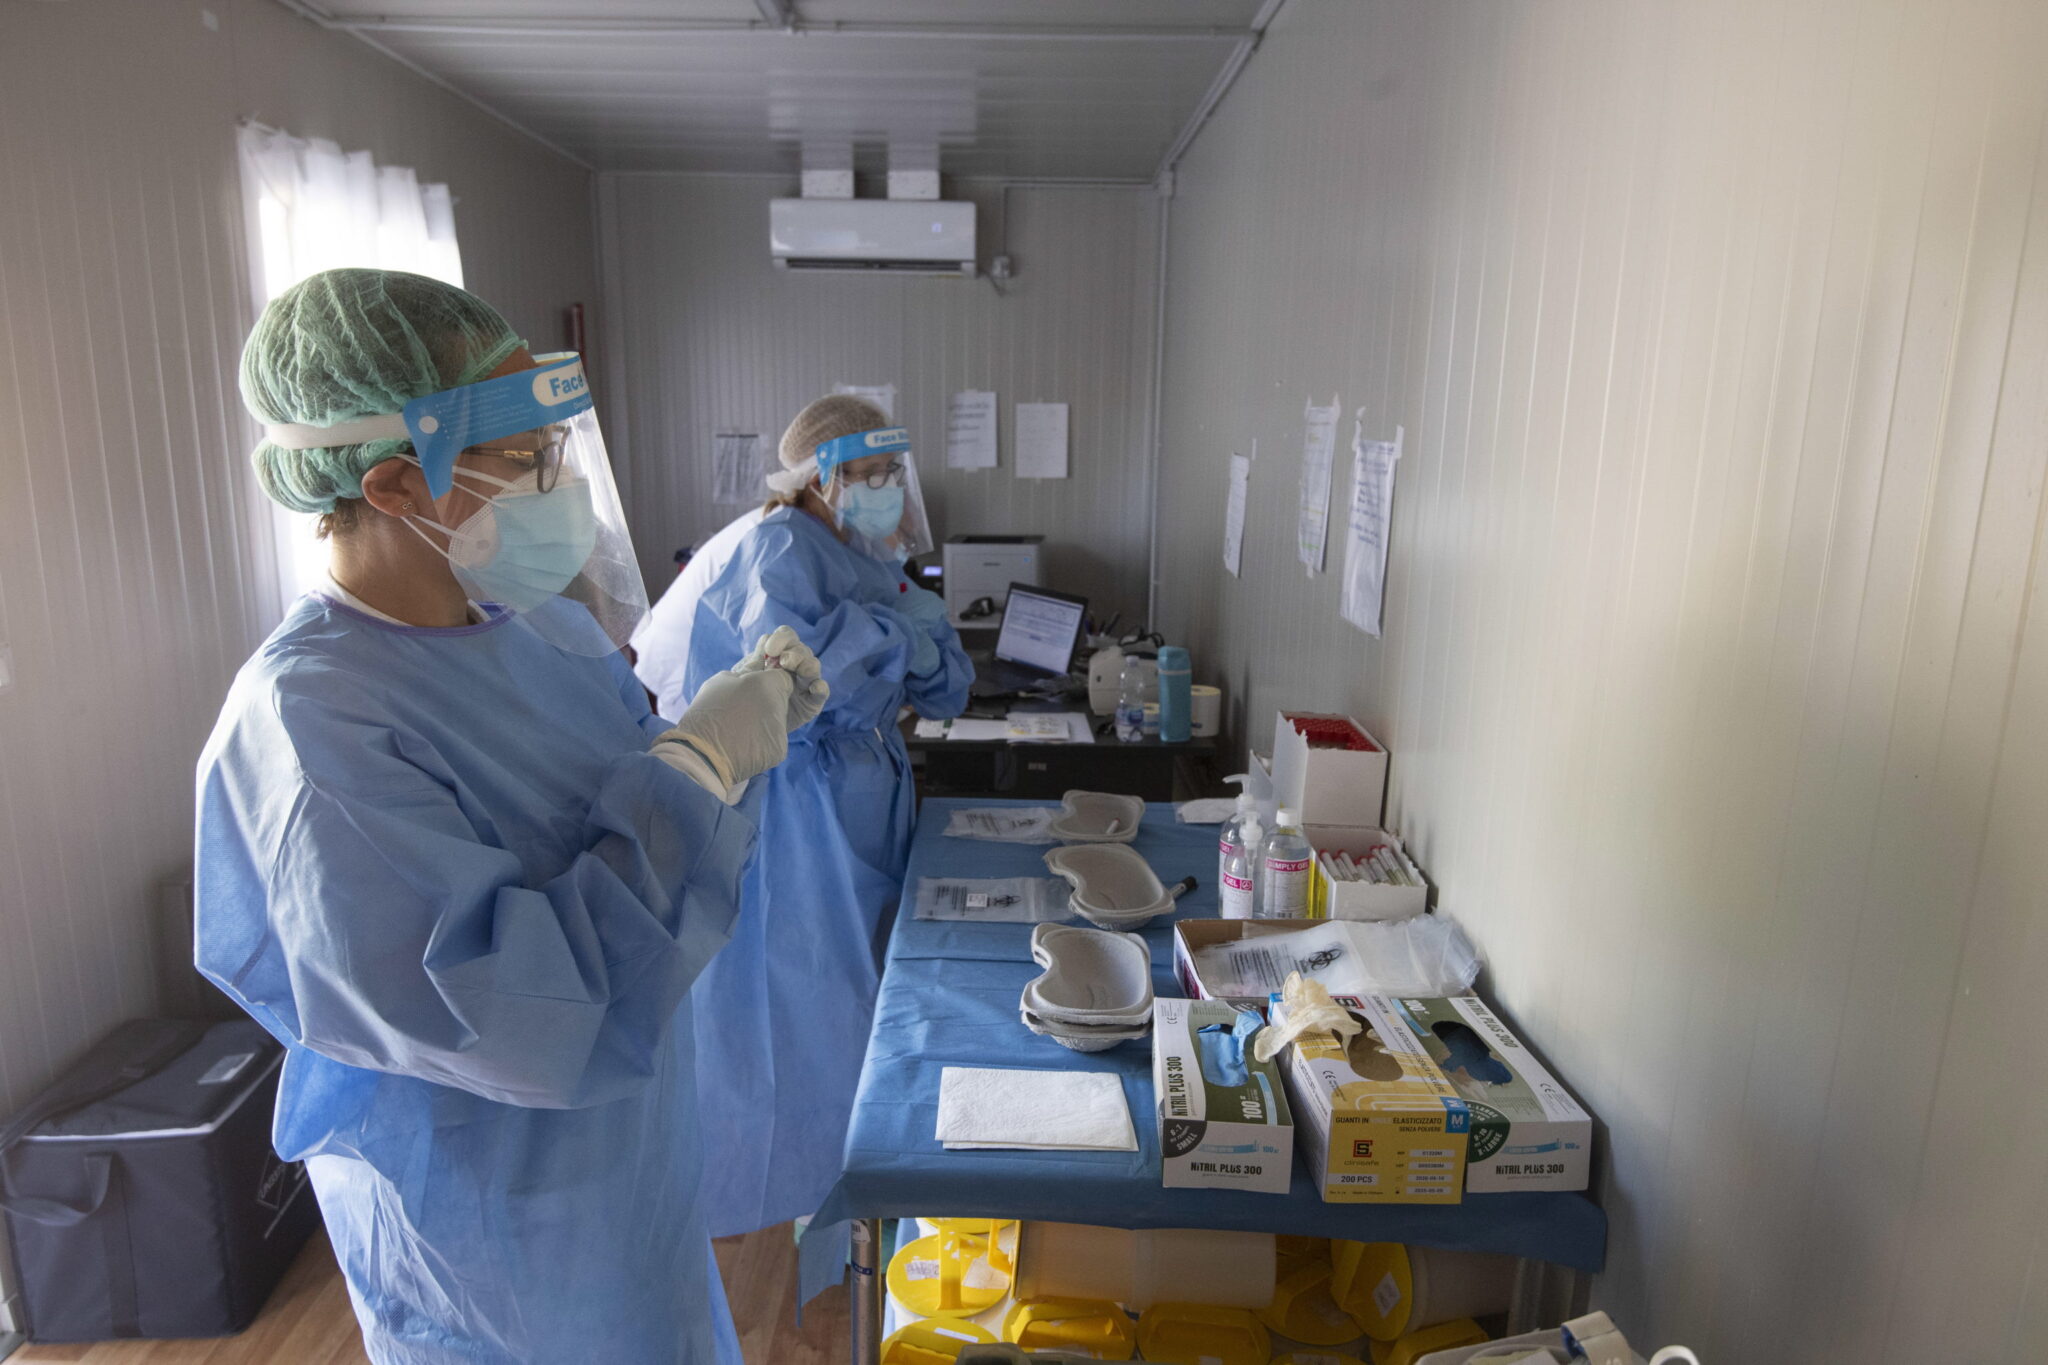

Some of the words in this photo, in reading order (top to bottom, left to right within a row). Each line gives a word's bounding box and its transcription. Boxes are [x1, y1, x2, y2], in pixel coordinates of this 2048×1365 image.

[1226, 877, 1239, 888] GEL
[1481, 1013, 1504, 1036] PLUS
[1497, 1030, 1519, 1049] 300
[1167, 1056, 1182, 1072] 300
[1169, 1073, 1185, 1093] PLUS
[1242, 1101, 1263, 1119] 100
[1451, 1114, 1464, 1125] M
[1176, 1131, 1198, 1151] SMALL
[1477, 1131, 1503, 1157] X-LARGE
[1220, 1163, 1242, 1174] PLUS
[1244, 1165, 1262, 1176] 300
[1523, 1165, 1545, 1175] PLUS
[1546, 1164, 1564, 1174] 300
